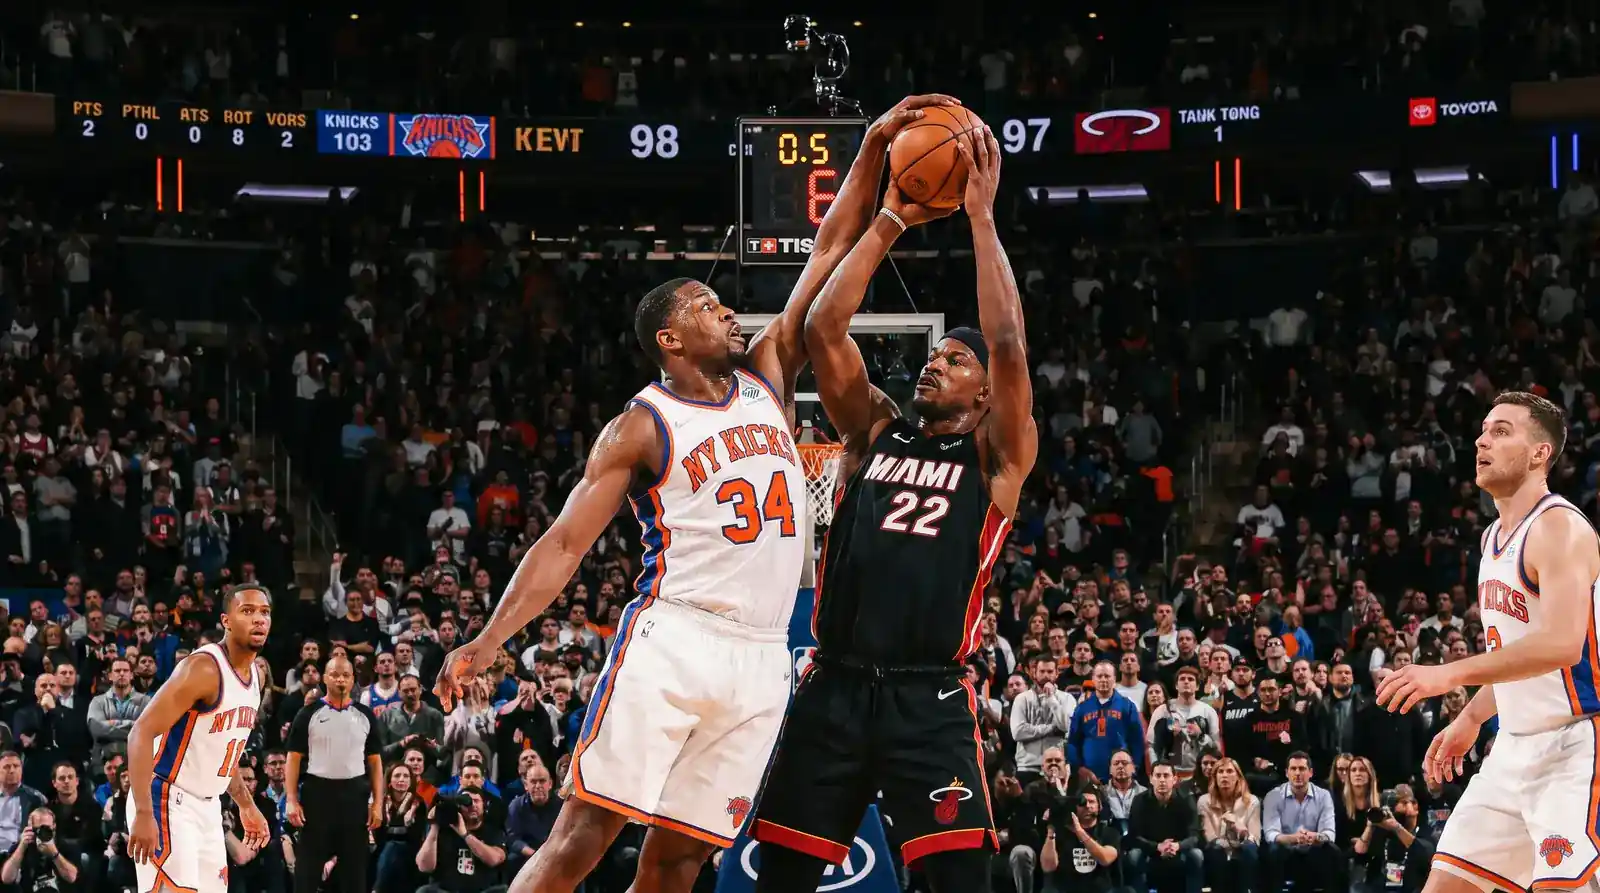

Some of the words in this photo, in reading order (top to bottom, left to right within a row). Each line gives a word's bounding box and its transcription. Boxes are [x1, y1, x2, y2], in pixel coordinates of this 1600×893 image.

[73, 101, 103, 117] PTS
[122, 104, 160, 120] PTHL
[180, 107, 209, 122] ATS
[223, 110, 253, 125] ROT
[266, 112, 307, 128] VORS
[325, 113, 379, 130] KNICKS
[1439, 100, 1498, 117] TOYOTA
[82, 119, 95, 137] 2
[135, 122, 148, 140] 0
[189, 125, 201, 143] 0
[232, 128, 244, 146] 8
[281, 131, 293, 148] 2
[333, 132, 372, 152] 103
[630, 124, 679, 159] 98
[1002, 118, 1051, 153] 97
[1213, 125, 1223, 142] 1
[778, 133, 829, 165] 0.5
[778, 238, 815, 254] TIS
[681, 436, 721, 494] NY
[719, 423, 796, 467] KICKS
[863, 452, 964, 491] MIAMI
[715, 470, 796, 545] 34
[880, 490, 951, 536] 22
[208, 708, 237, 734] NY
